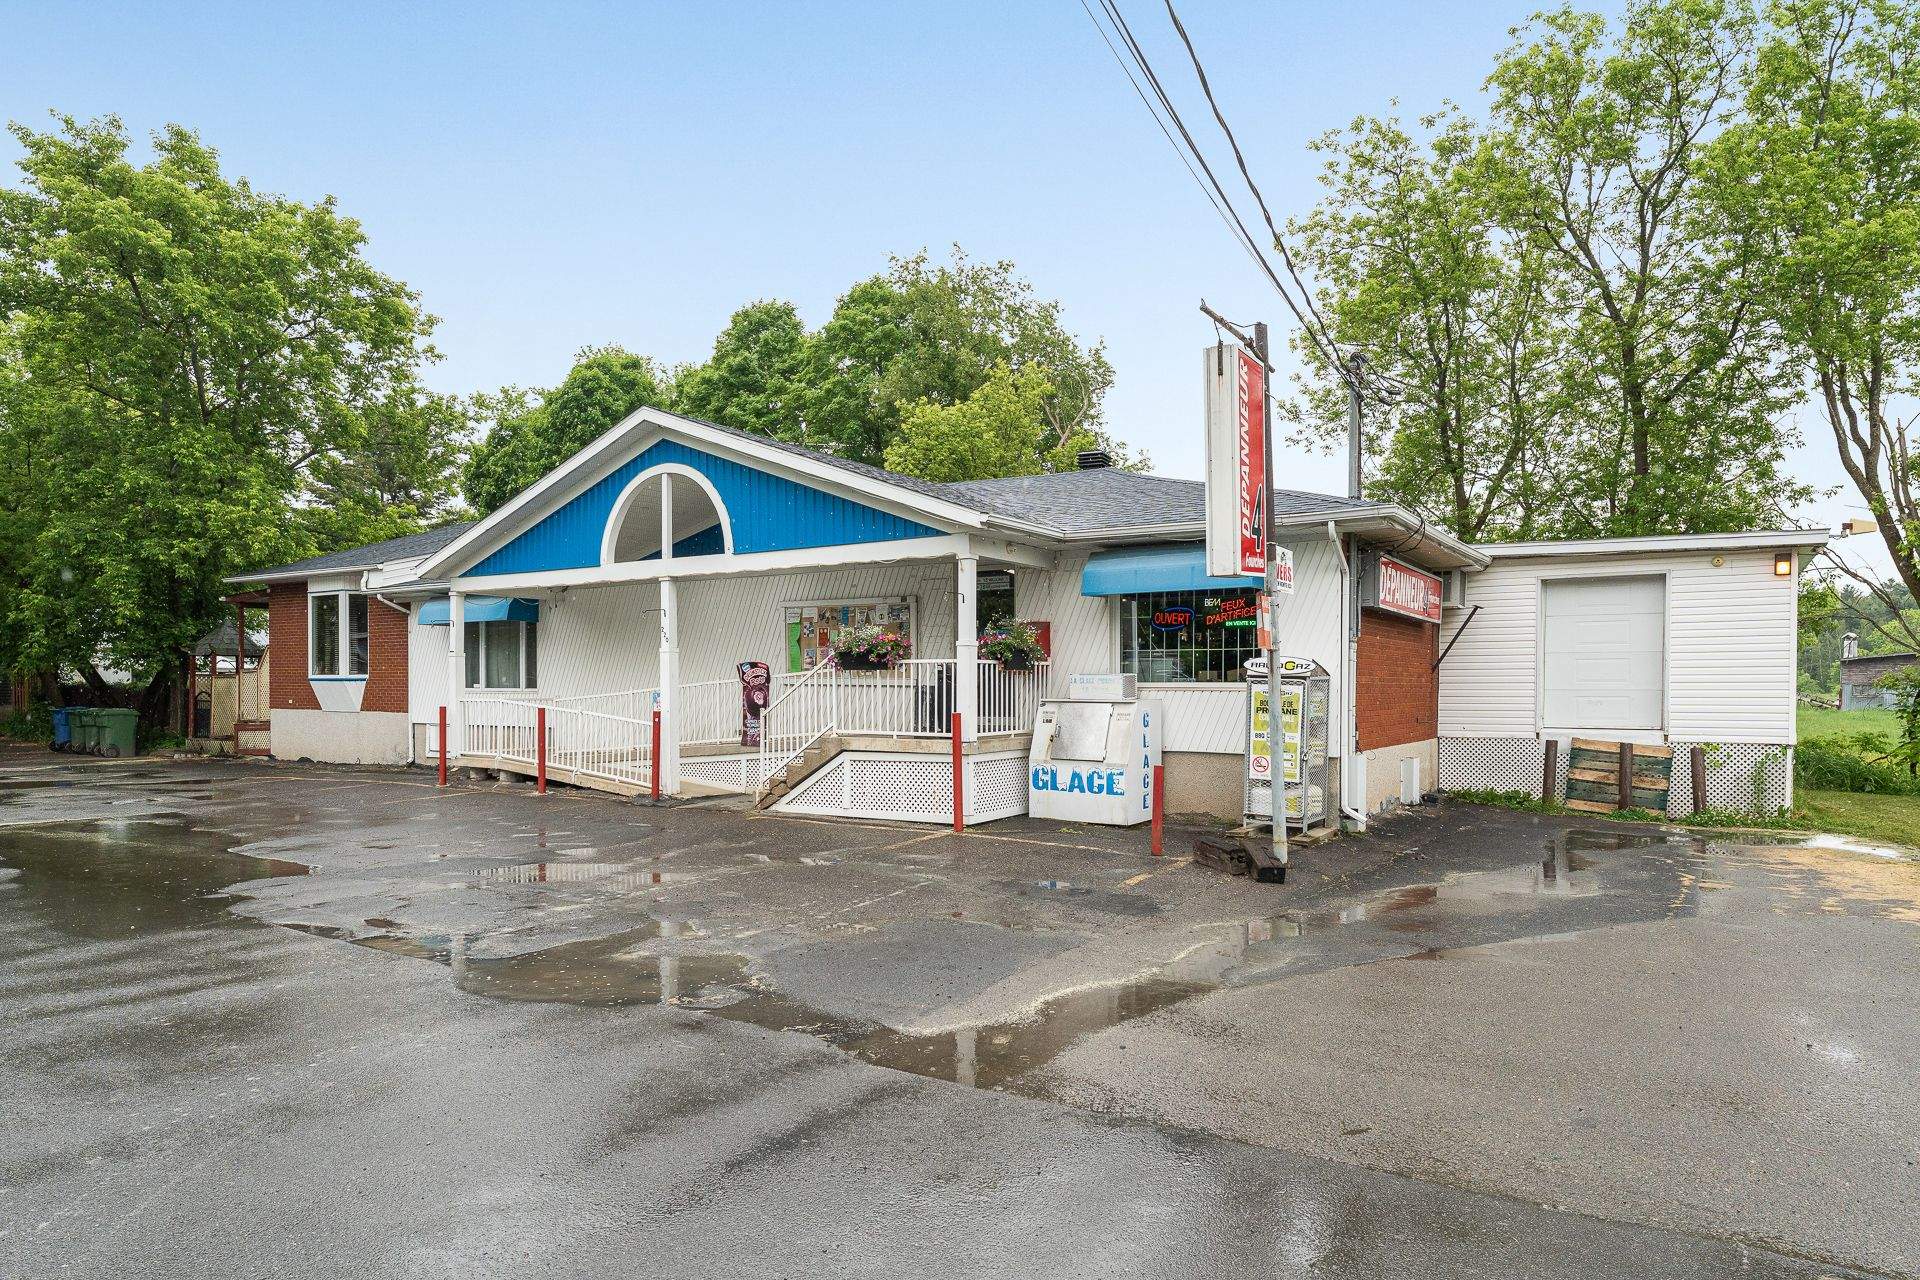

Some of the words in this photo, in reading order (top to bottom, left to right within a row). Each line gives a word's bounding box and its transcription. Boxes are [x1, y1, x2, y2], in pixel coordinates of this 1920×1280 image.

[1239, 357, 1250, 539] DEPANNEUR
[1250, 482, 1263, 553] 4
[1154, 612, 1191, 625] OUVERT
[1221, 597, 1246, 612] FEUX
[1031, 763, 1125, 797] GLACE
